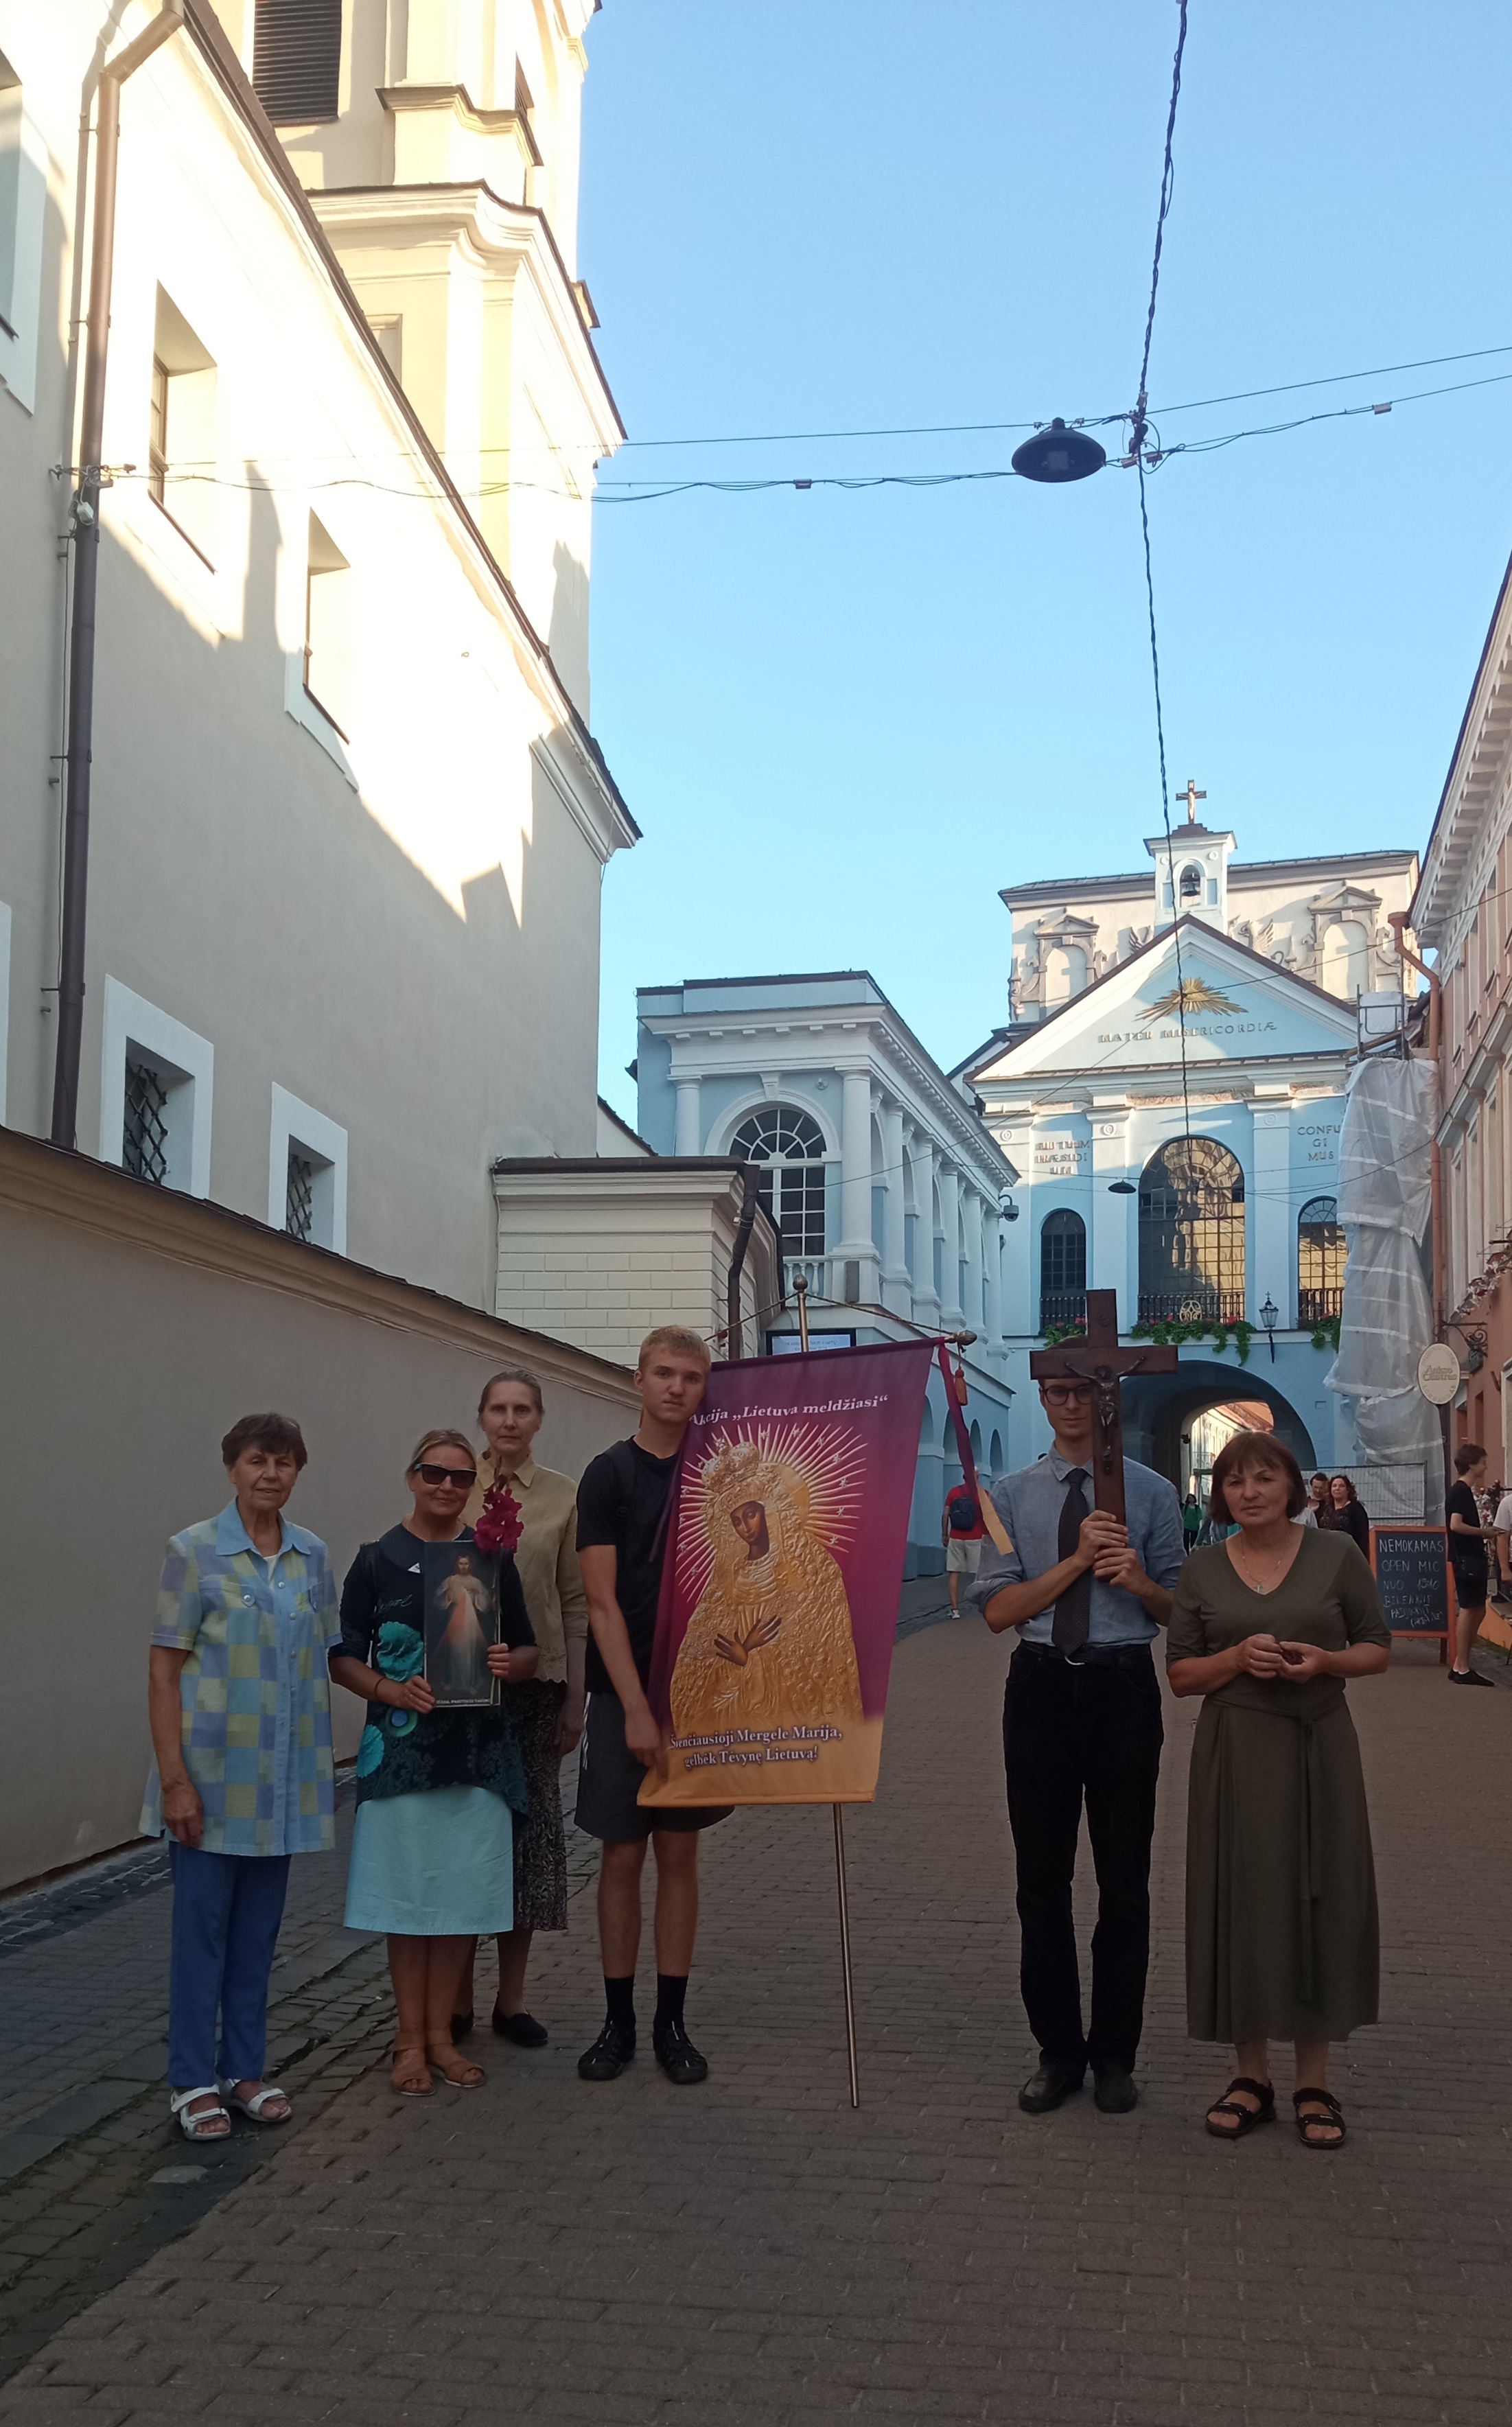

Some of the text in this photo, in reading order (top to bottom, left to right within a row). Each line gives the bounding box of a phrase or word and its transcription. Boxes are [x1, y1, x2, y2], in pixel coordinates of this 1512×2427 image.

[1297, 1125, 1341, 1135] CONFU
[1312, 1137, 1327, 1147] GI
[1308, 1150, 1334, 1161] MUS
[688, 1408, 728, 1426] Akcija
[1379, 1539, 1444, 1553] NEMOKAMAS
[1382, 1559, 1441, 1572] OPEN MIC
[1383, 1580, 1404, 1590] NUO
[737, 1728, 789, 1744] Mergele
[792, 1724, 842, 1741] Marija,
[684, 1745, 818, 1769] gelbėk Tėvynę Lietuvą!
